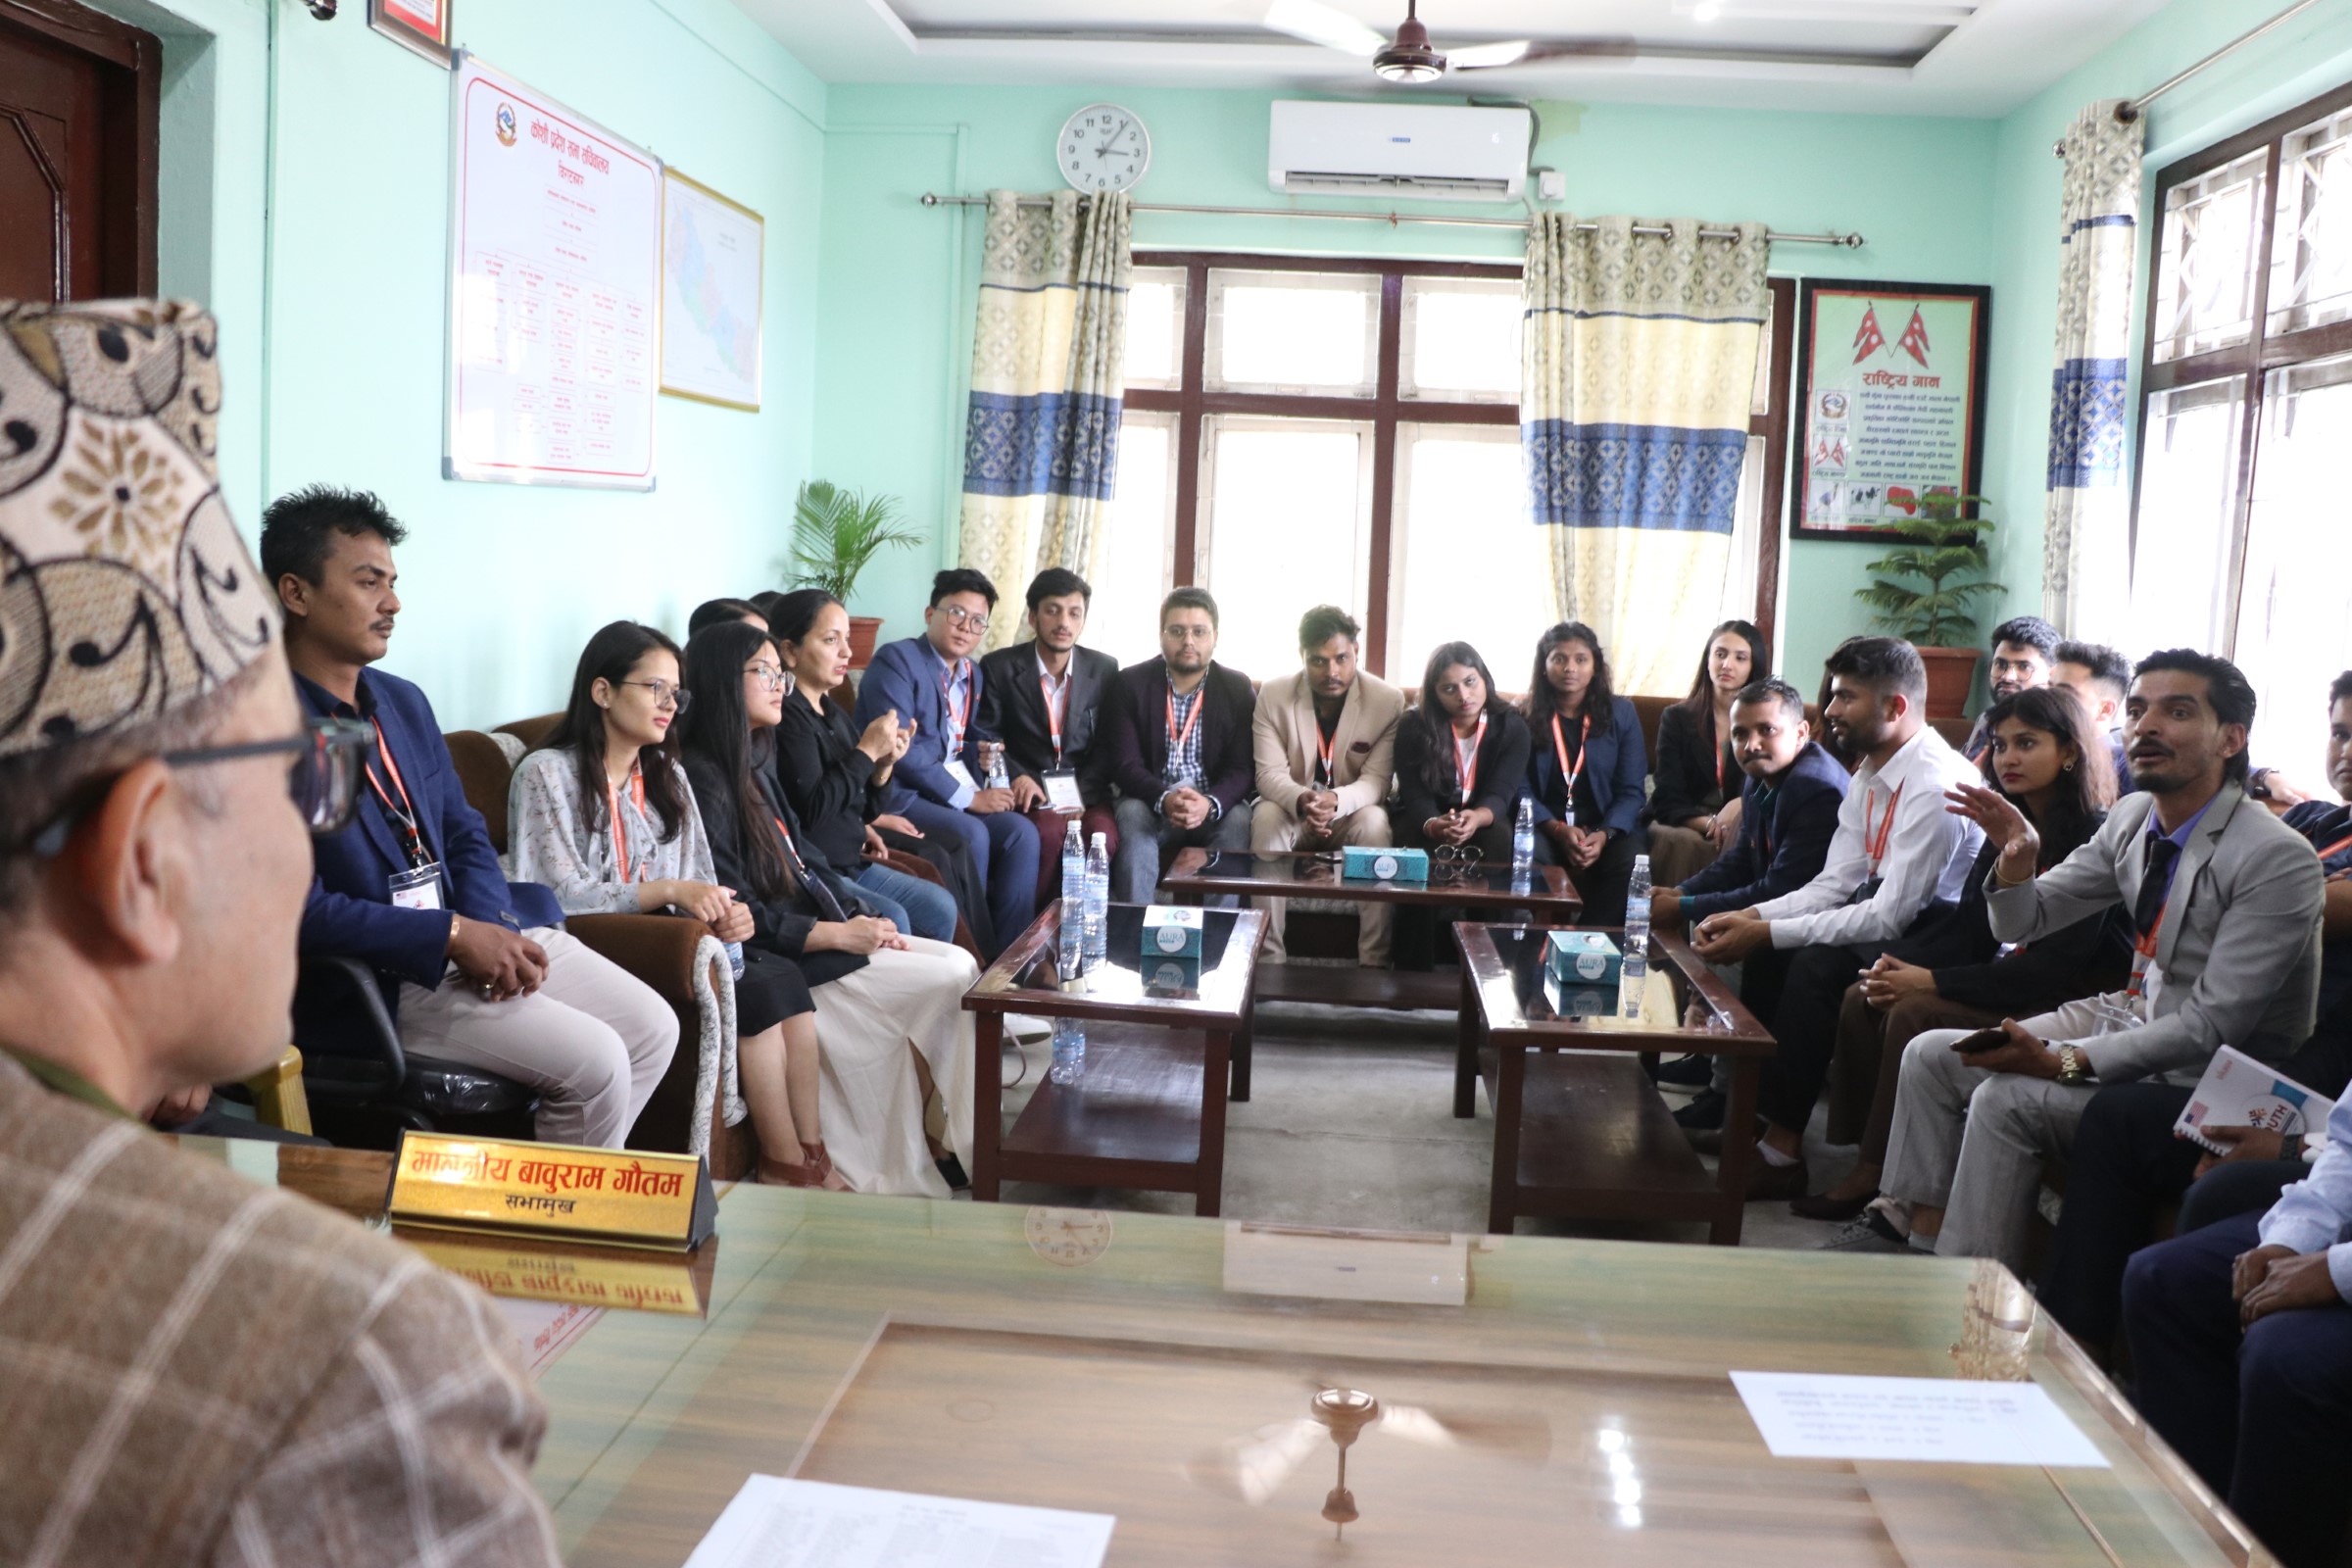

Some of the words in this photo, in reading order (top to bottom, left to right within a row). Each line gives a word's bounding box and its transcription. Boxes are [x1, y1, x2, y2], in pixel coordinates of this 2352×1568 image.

[1086, 119, 1095, 127] 11
[1102, 115, 1111, 124] 12
[1074, 128, 1085, 138] 10
[1129, 131, 1137, 141] 2
[1068, 144, 1075, 154] 9
[1133, 148, 1140, 158] 3
[1072, 161, 1079, 171] 8
[1126, 165, 1133, 173] 4
[1085, 173, 1092, 183] 7
[1099, 177, 1105, 187] 6
[1114, 174, 1121, 184] 5
[612, 1160, 685, 1198] गौतम
[506, 1195, 576, 1218] सभामुख
